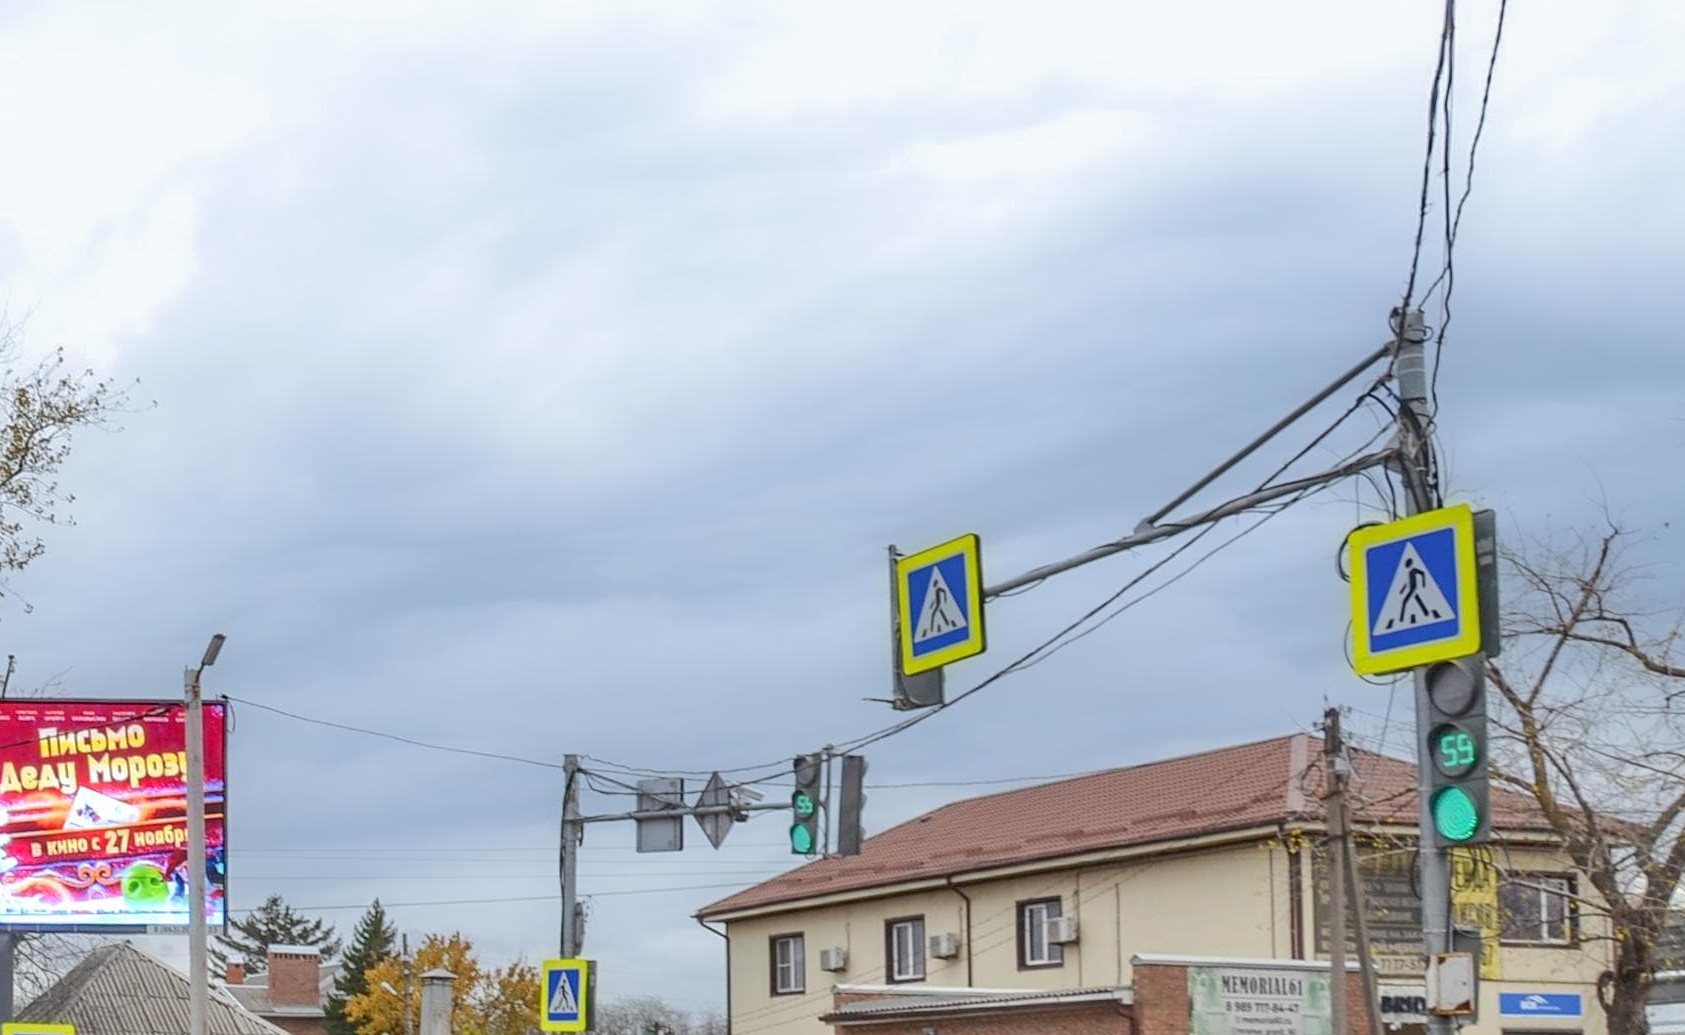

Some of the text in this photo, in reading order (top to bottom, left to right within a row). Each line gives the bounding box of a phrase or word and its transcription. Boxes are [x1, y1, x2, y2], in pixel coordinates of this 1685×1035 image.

[38, 723, 145, 758] Письмо
[1441, 734, 1474, 766] 55
[31, 824, 188, 857] в кино с 27 ноябр
